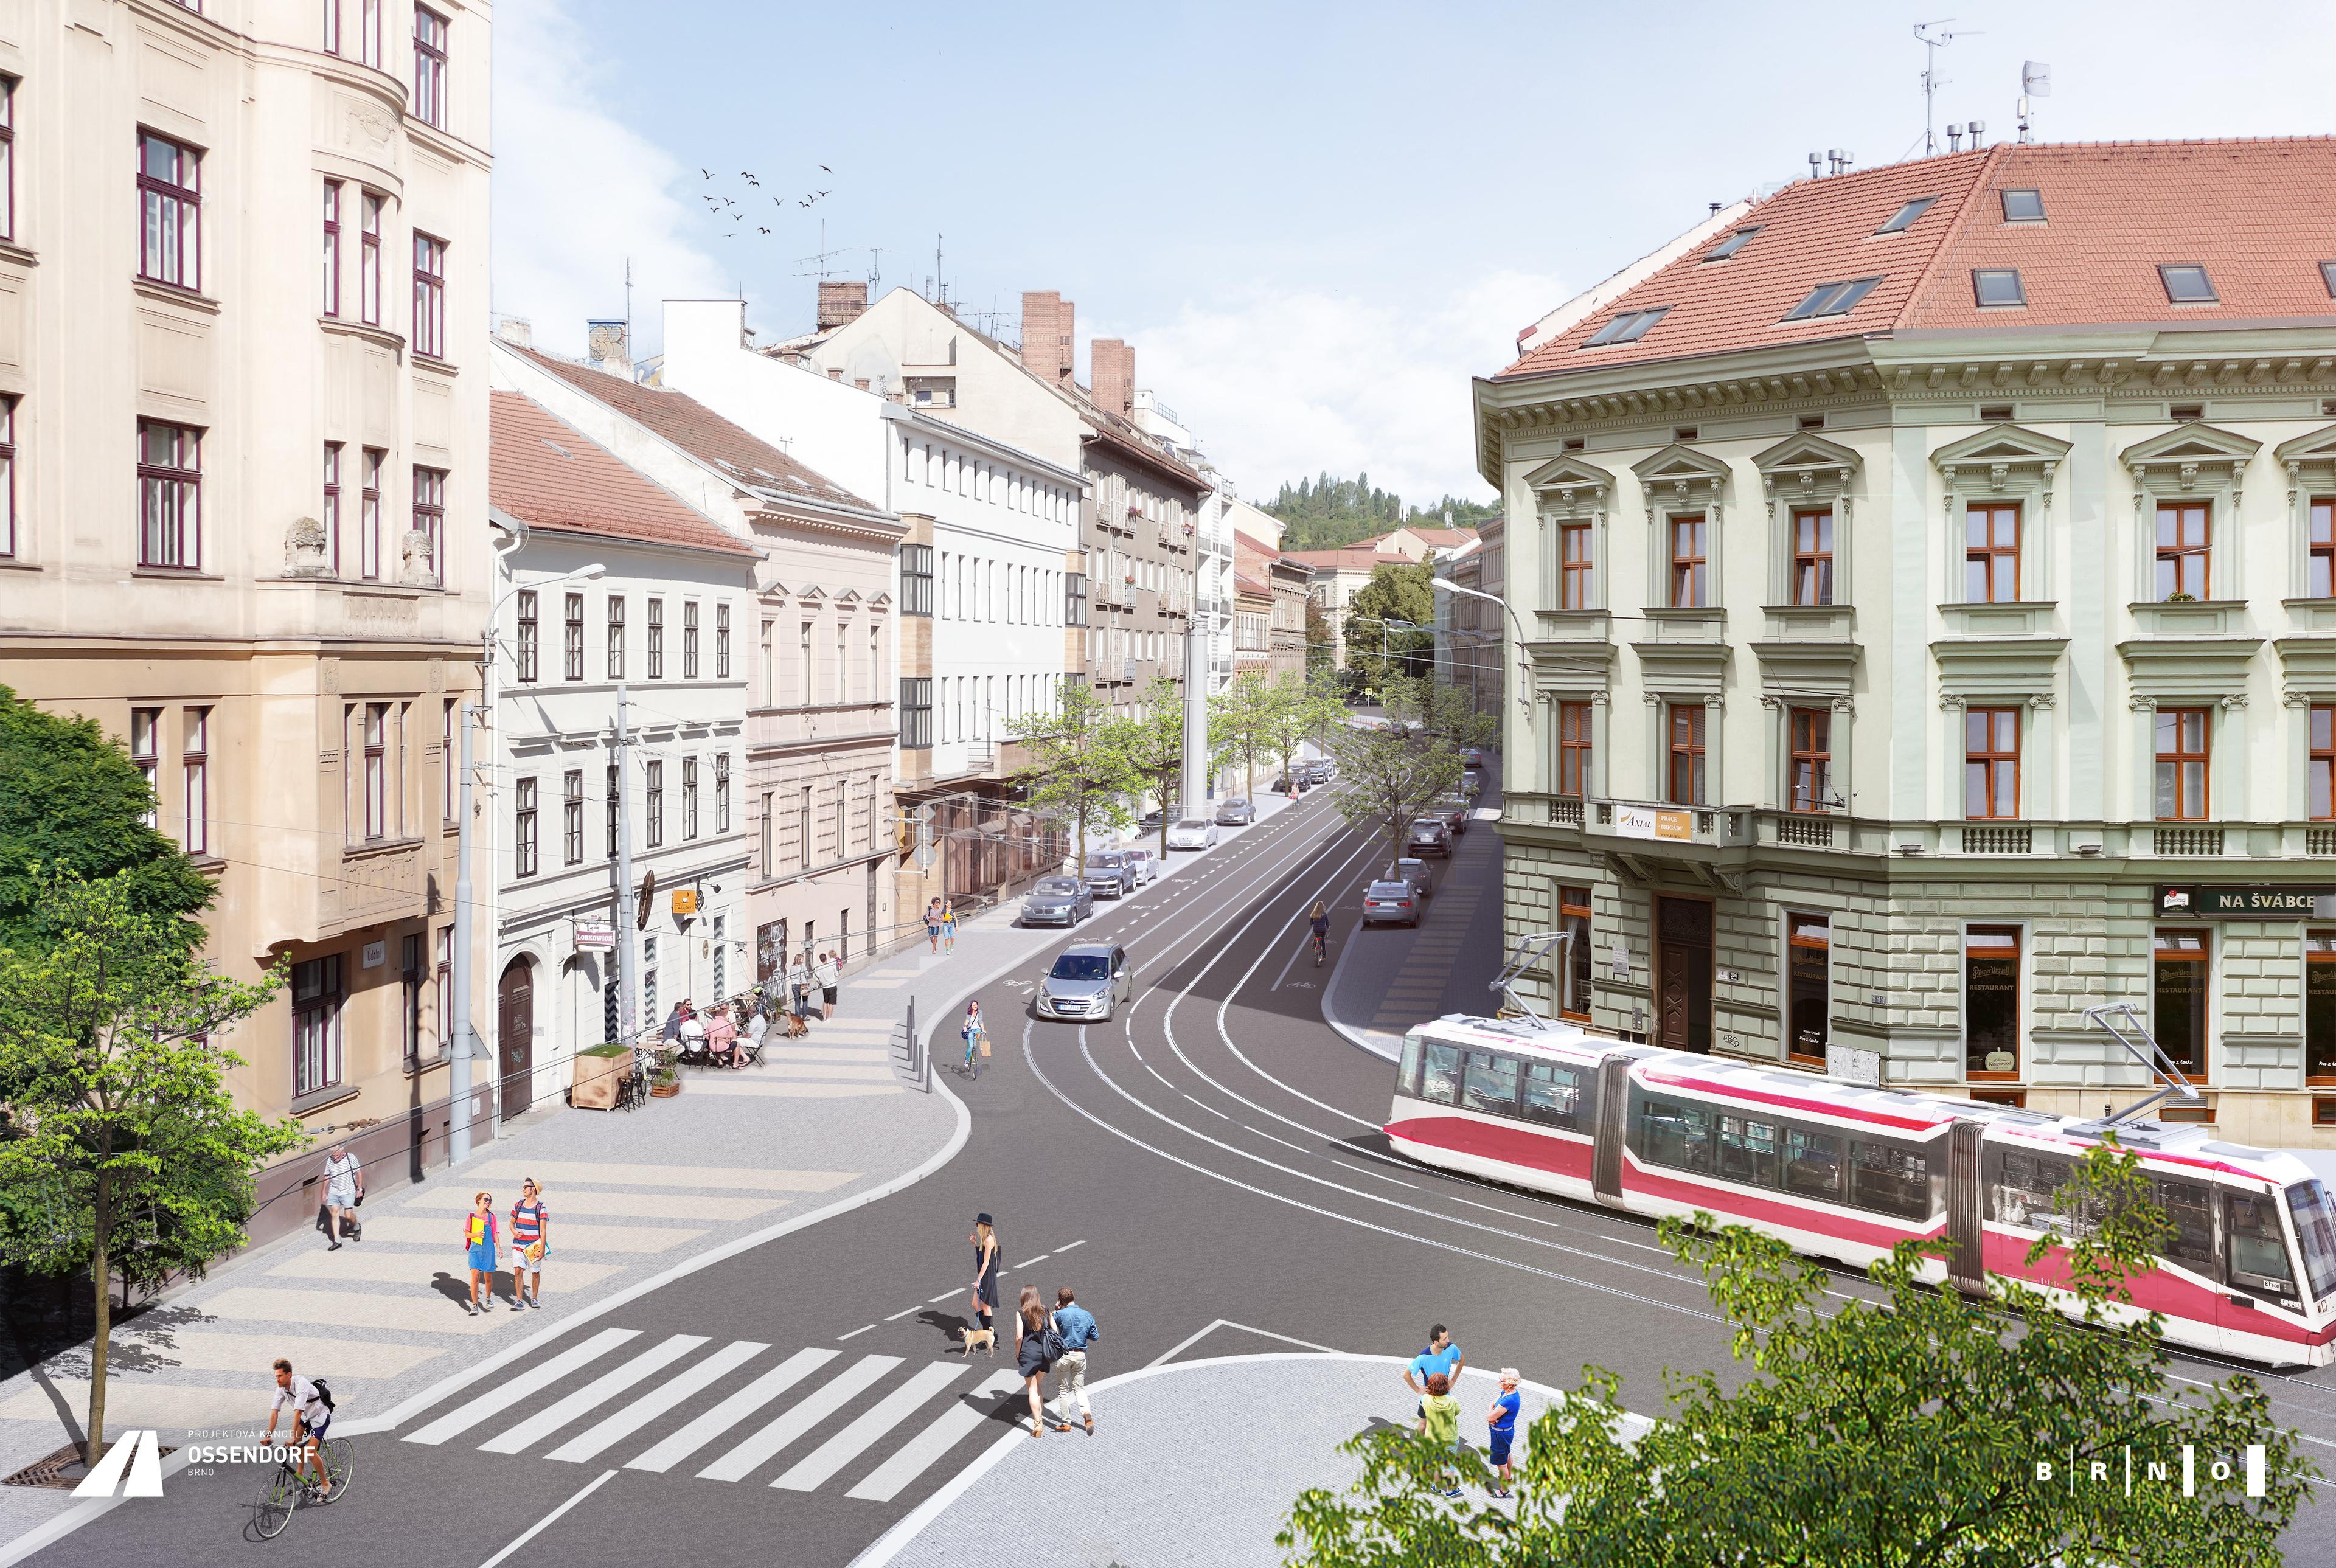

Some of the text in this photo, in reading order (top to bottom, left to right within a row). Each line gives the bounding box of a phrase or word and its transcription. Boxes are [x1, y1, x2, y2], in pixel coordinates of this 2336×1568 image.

[2220, 893, 2315, 907] NA ŠVÁBCE
[1794, 971, 1827, 980] RESTAURANT
[1973, 965, 2009, 979] Pilsner Urquell
[2160, 968, 2178, 982] Pilsner
